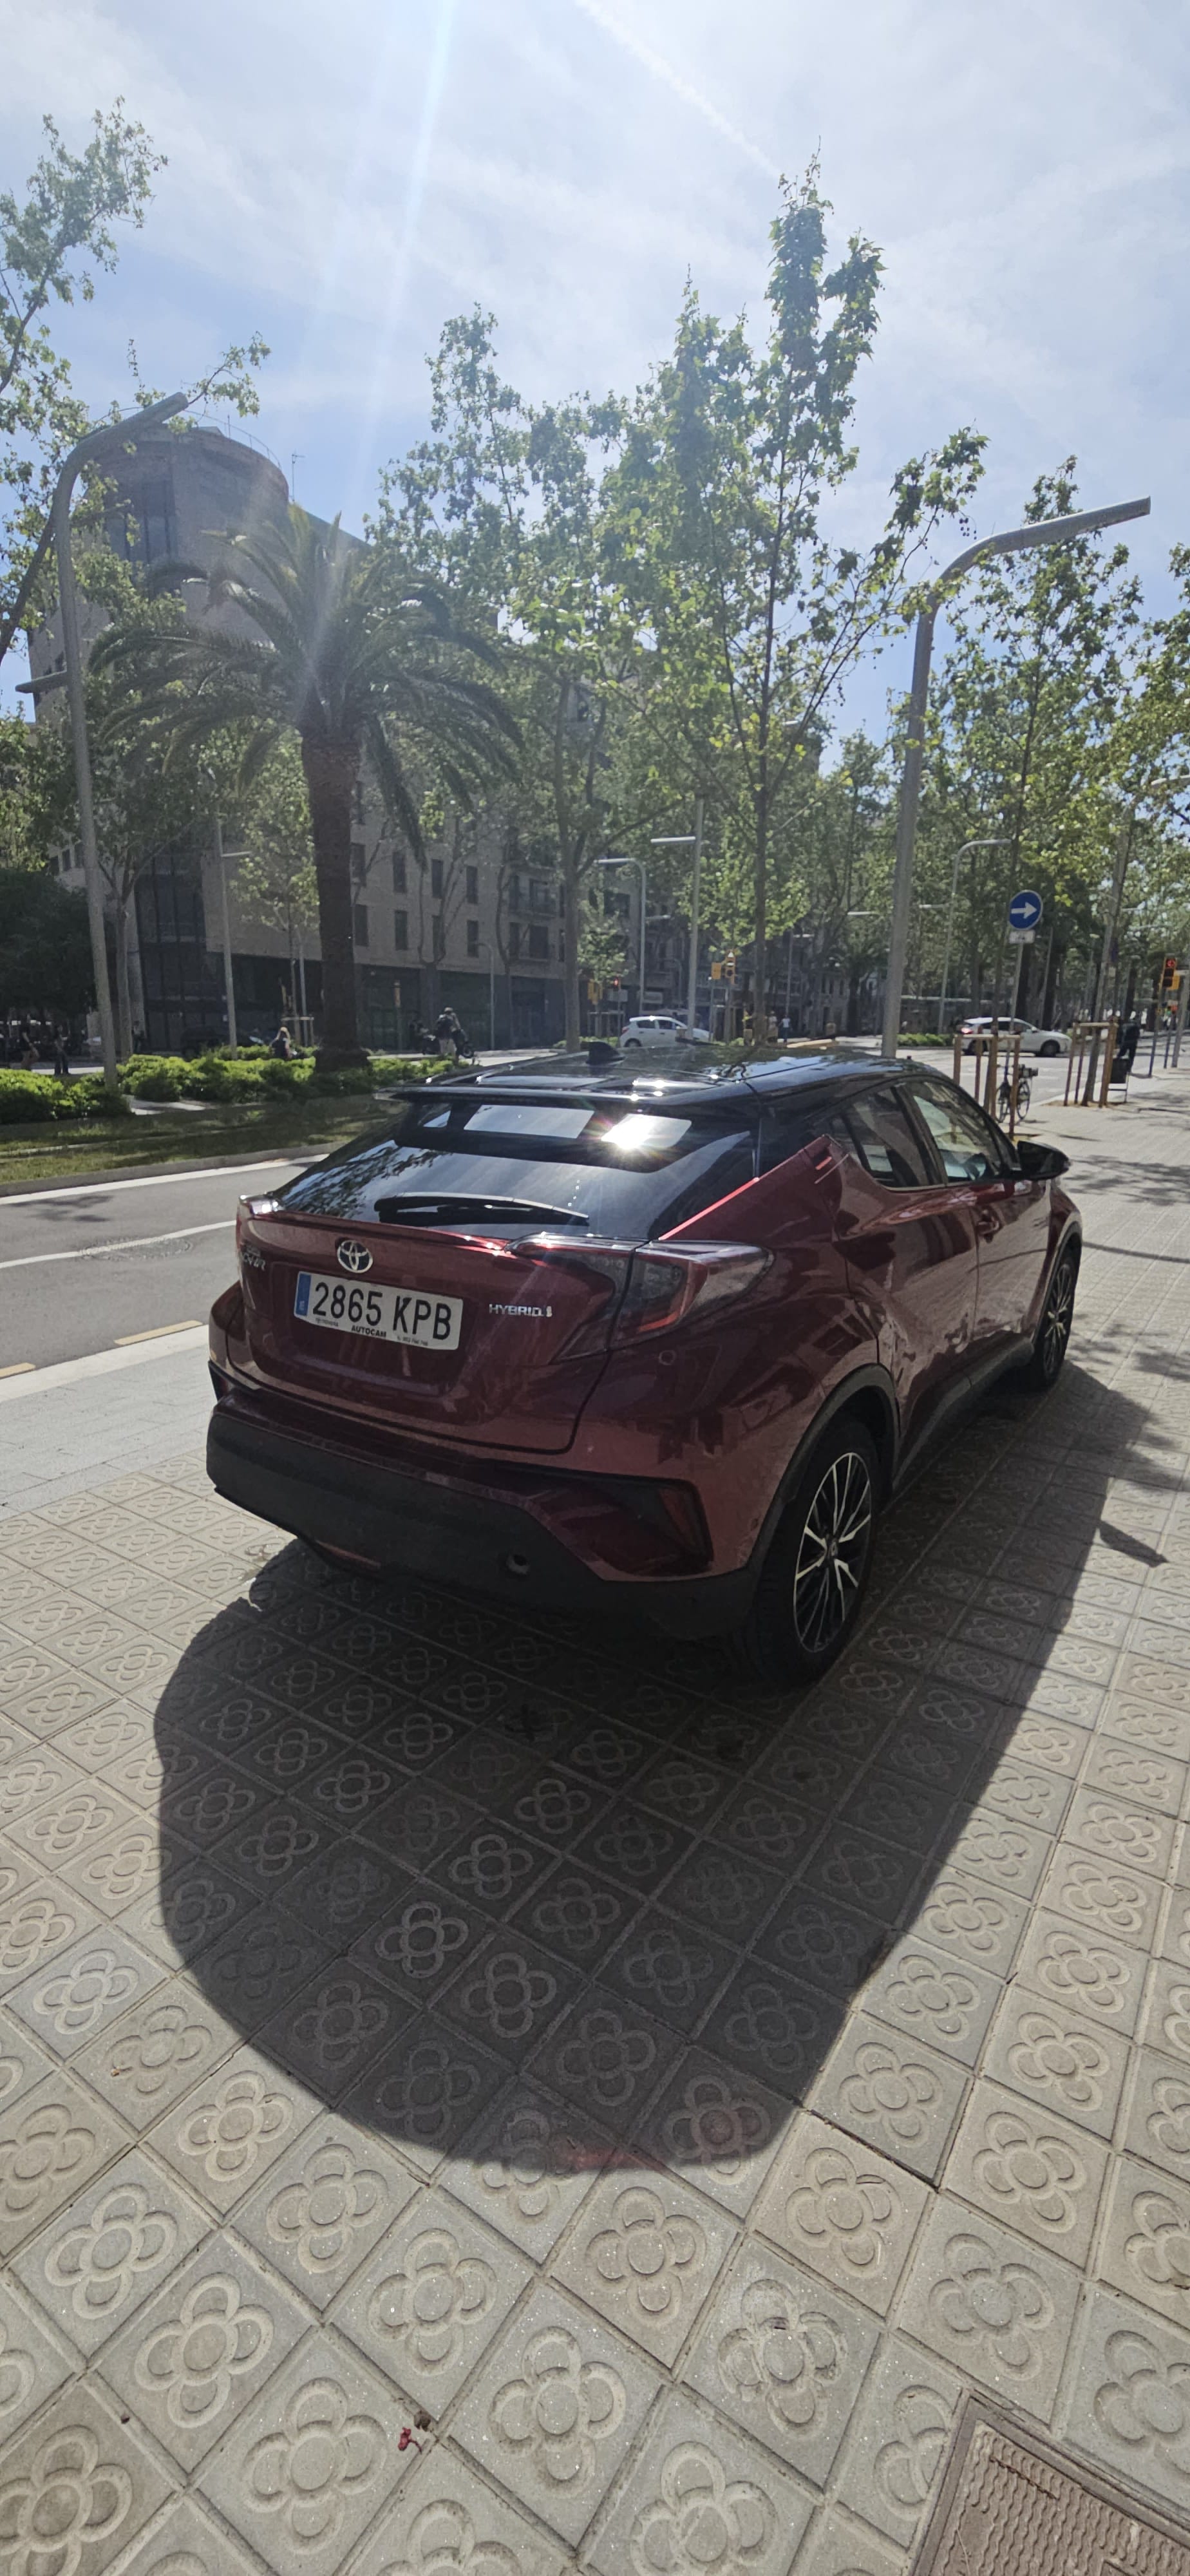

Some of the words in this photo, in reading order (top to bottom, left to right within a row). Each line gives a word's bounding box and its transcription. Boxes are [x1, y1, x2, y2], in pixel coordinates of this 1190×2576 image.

[312, 1282, 382, 1327] 2865
[393, 1295, 451, 1340] KPB
[489, 1303, 544, 1317] HYBRID
